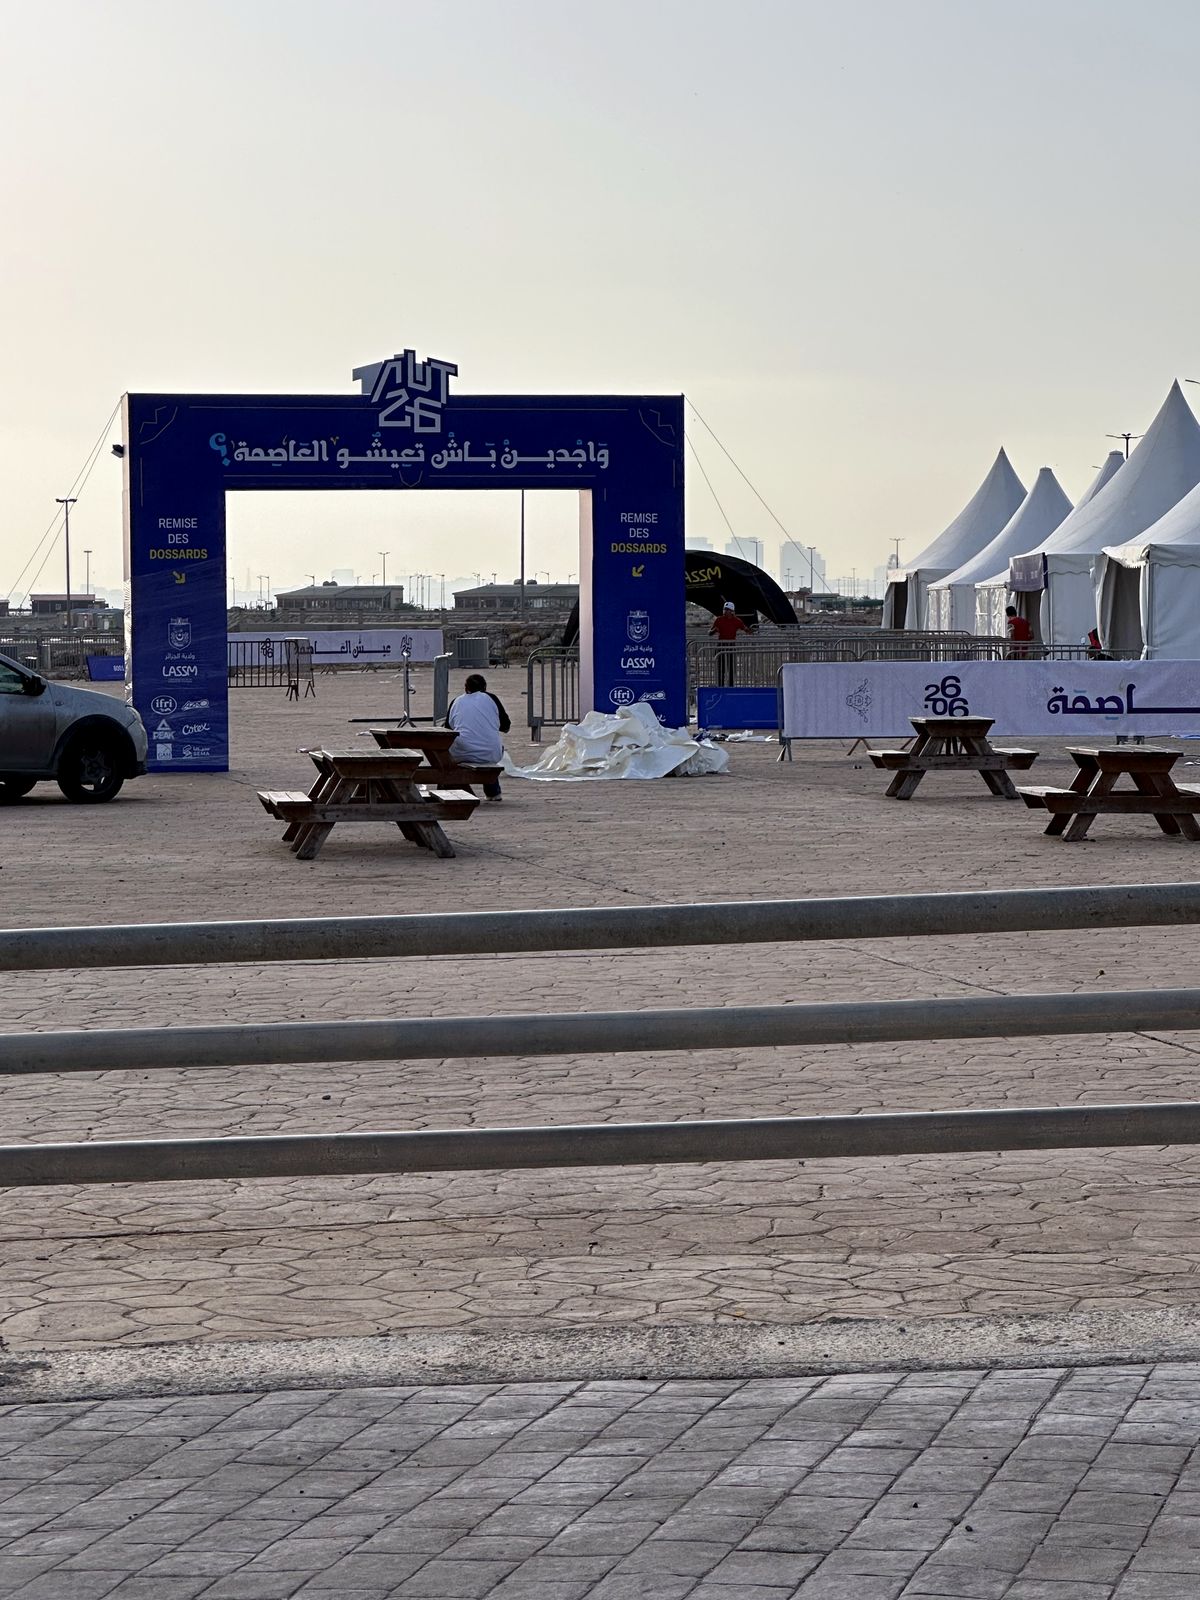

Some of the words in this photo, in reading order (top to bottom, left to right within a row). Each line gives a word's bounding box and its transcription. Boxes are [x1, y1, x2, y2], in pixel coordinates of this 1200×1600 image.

[378, 388, 441, 433] 26
[620, 512, 658, 523] REMISE
[158, 518, 198, 529] REMISE
[168, 533, 189, 544] DES
[629, 528, 649, 538] DES
[611, 543, 667, 554] DOSSARDS
[149, 549, 208, 560] DOSSARDS
[685, 566, 721, 582] ASSM
[621, 657, 655, 669] LASSM
[162, 665, 198, 677] LASSM
[152, 731, 176, 740] PEAK
